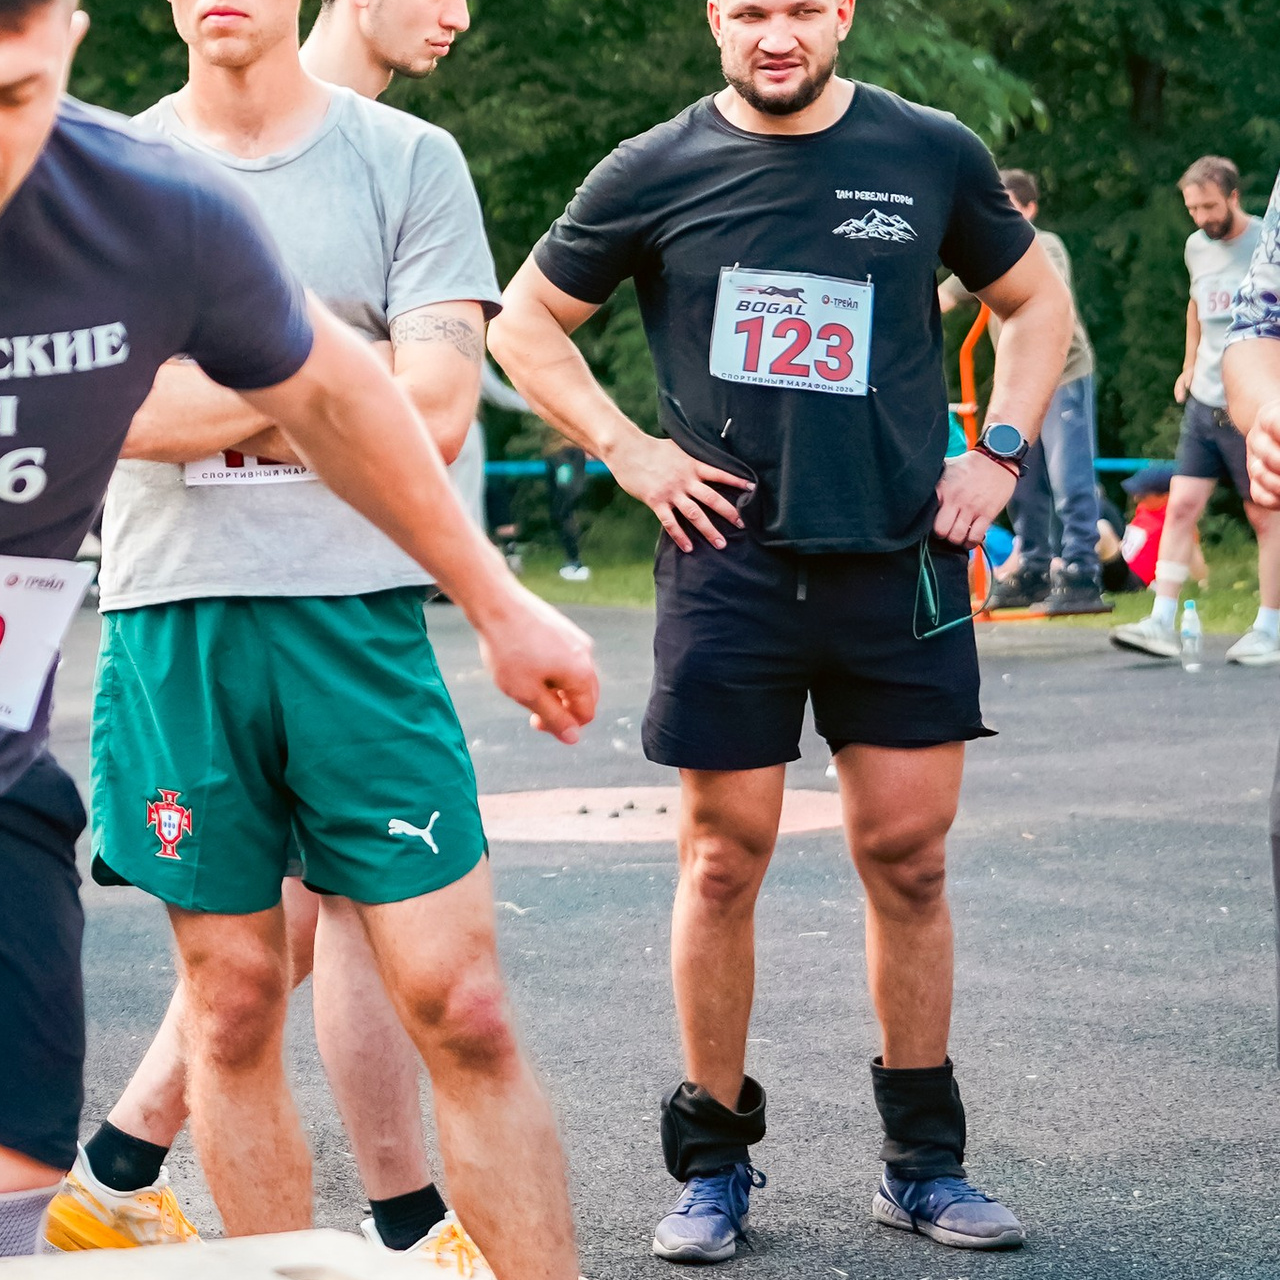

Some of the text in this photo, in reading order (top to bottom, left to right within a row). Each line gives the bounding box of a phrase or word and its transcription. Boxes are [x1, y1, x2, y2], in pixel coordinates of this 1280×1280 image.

[835, 190, 853, 200] ТАМ
[735, 300, 806, 316] BOGAL
[734, 316, 854, 382] 123
[786, 380, 834, 392] МАРАФОН
[201, 466, 312, 480] СПОРТИВНЫЙ МАР
